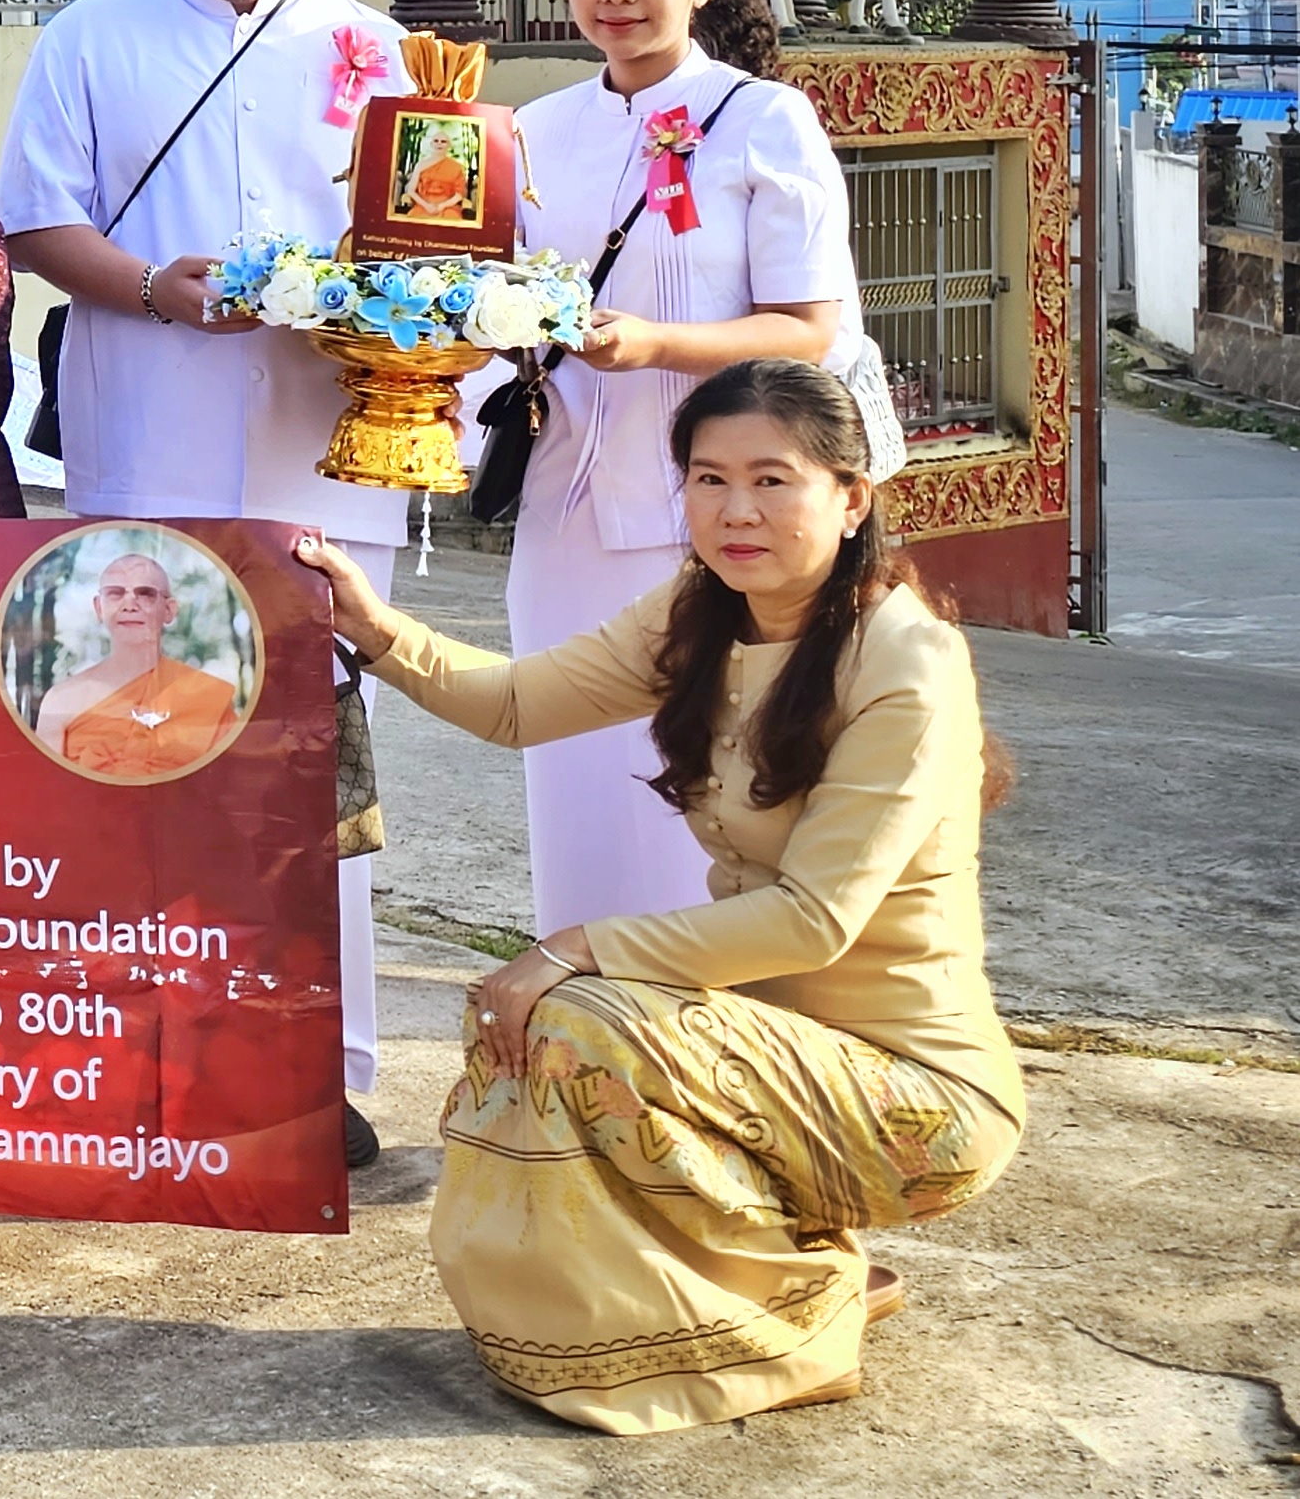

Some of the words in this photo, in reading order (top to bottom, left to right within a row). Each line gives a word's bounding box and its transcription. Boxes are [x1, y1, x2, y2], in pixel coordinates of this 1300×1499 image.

[3, 844, 62, 901] by
[17, 991, 123, 1039] 80th
[52, 1056, 104, 1102] of
